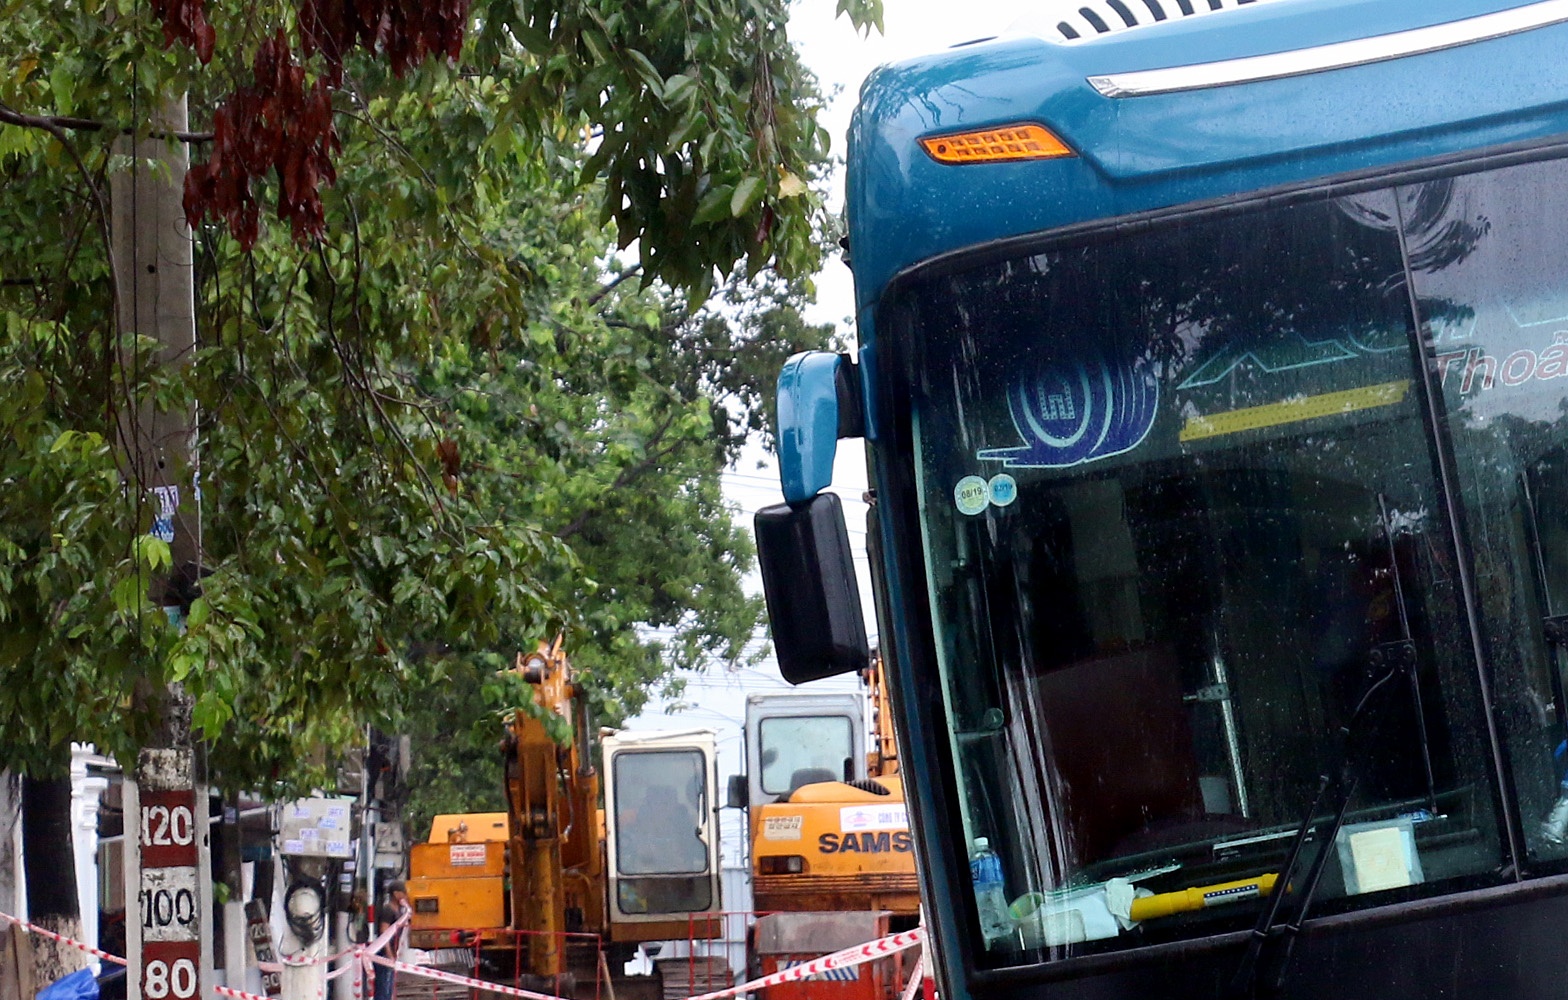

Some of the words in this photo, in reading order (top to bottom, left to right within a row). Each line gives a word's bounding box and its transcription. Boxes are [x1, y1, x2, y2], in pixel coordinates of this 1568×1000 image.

[962, 487, 982, 499] 08/19
[142, 804, 194, 847] 120
[818, 831, 912, 854] SAMS
[138, 888, 195, 928] 100
[144, 958, 197, 1000] 80
